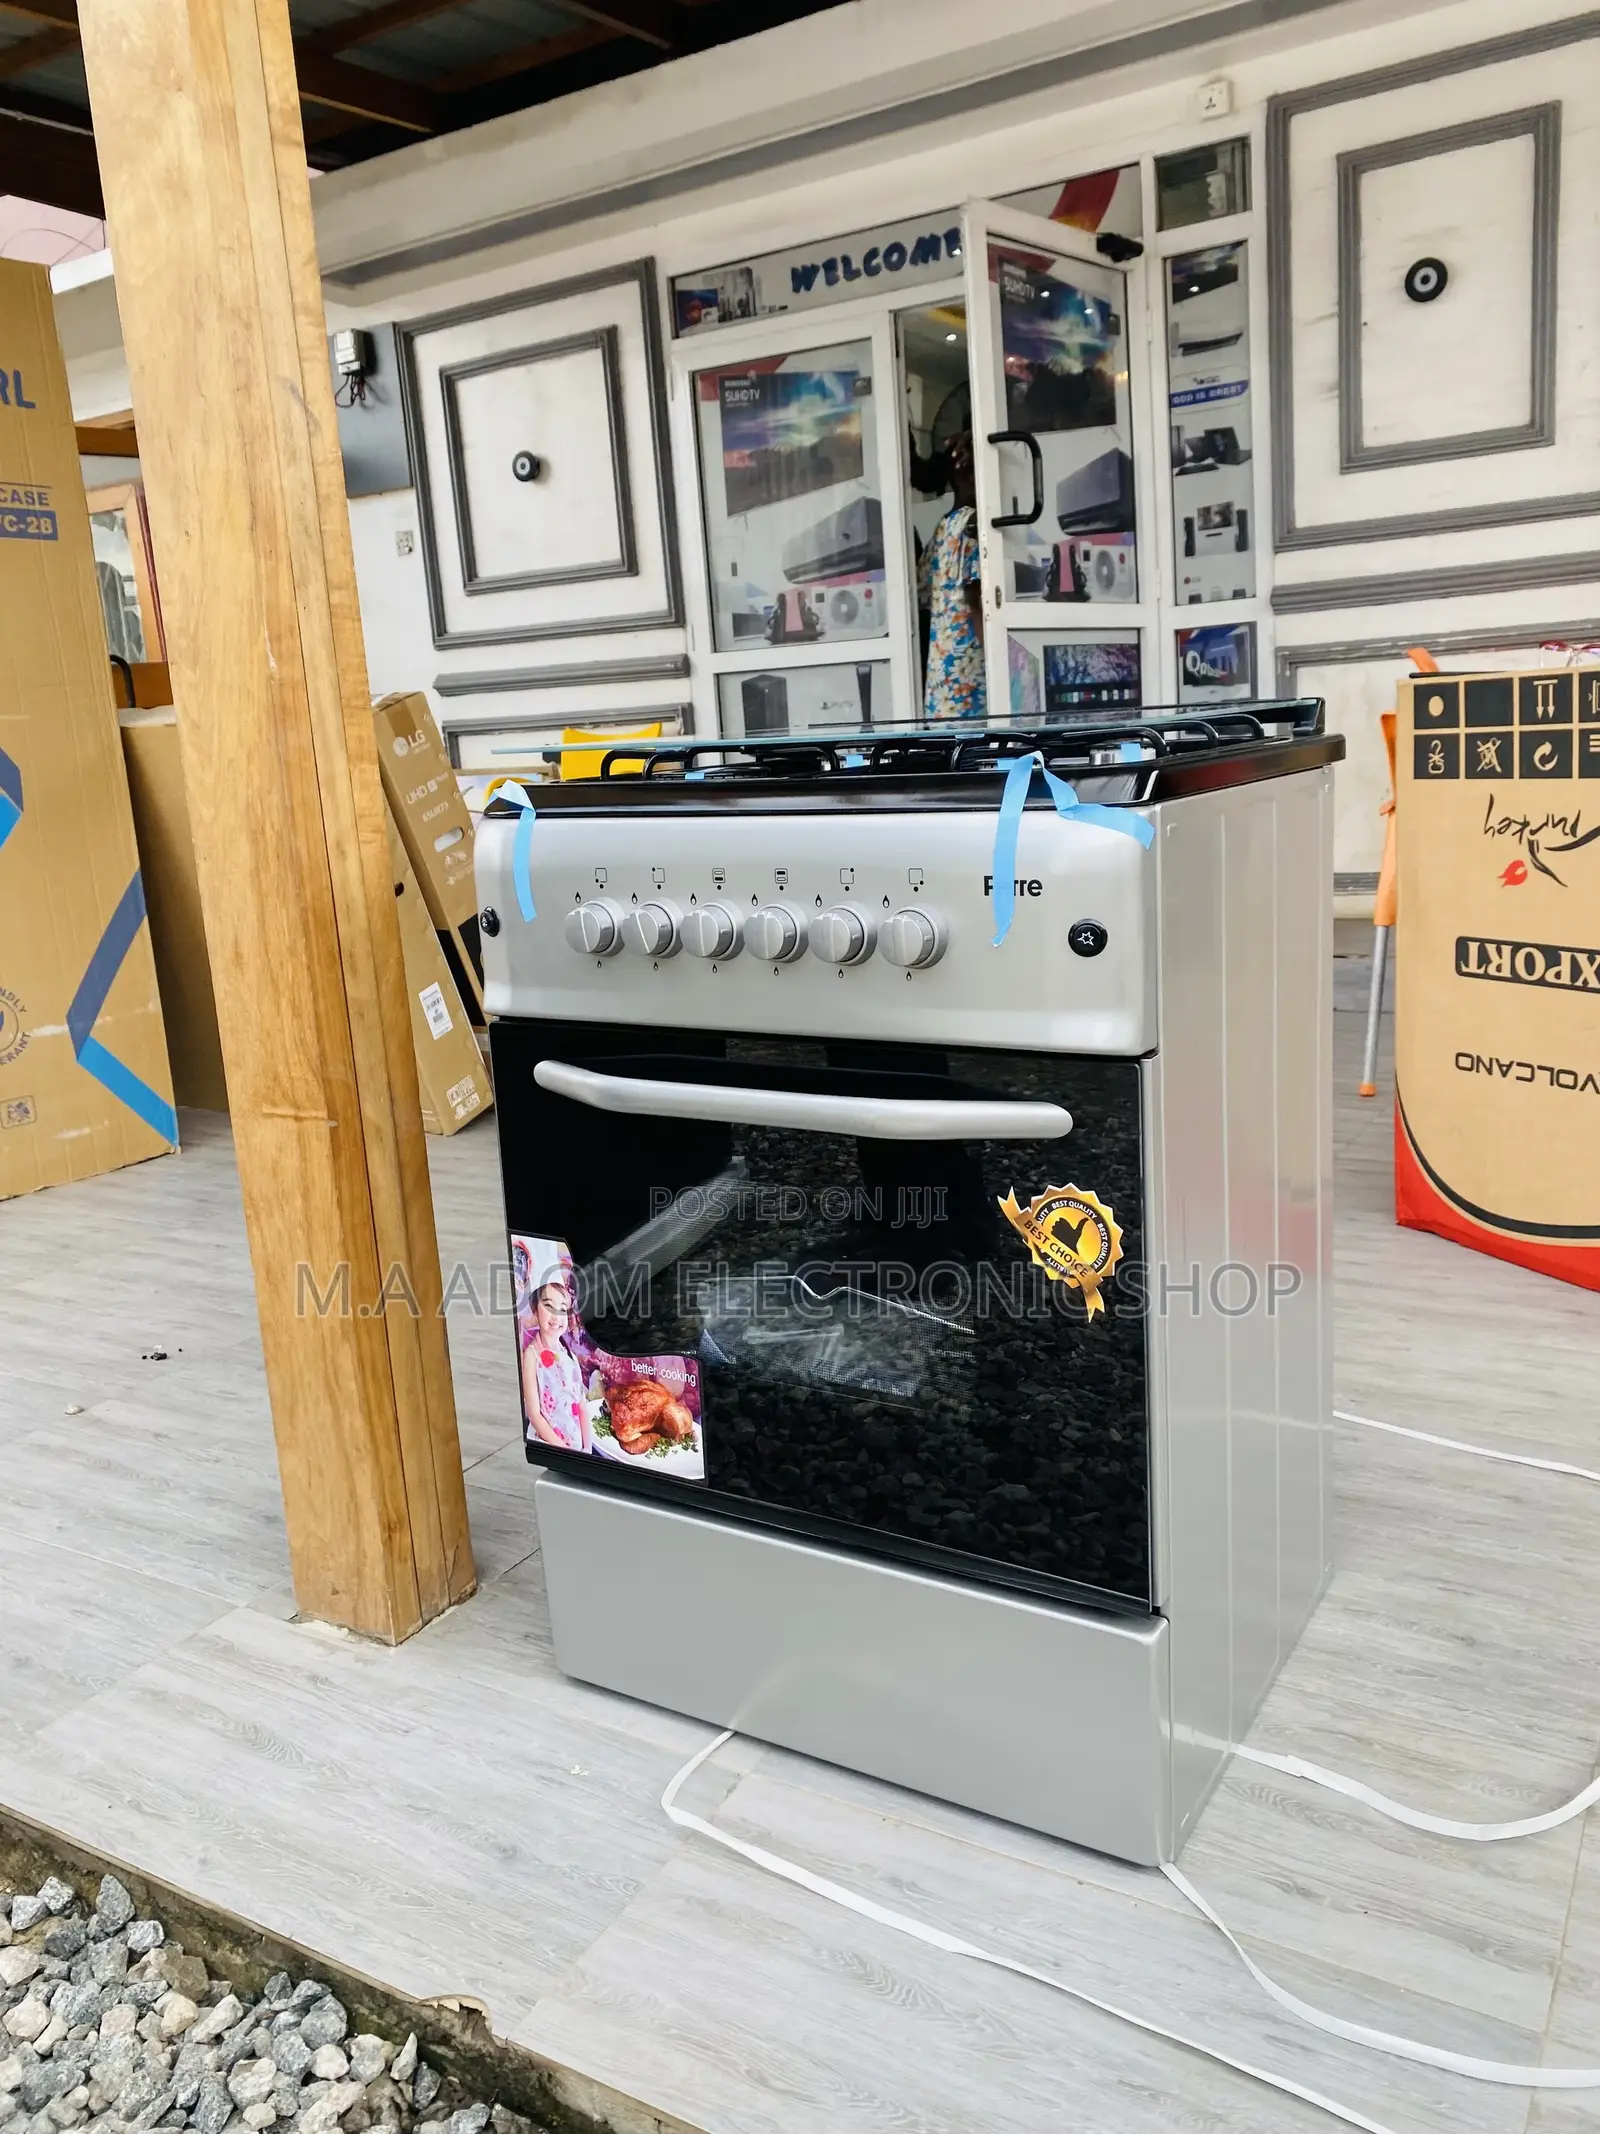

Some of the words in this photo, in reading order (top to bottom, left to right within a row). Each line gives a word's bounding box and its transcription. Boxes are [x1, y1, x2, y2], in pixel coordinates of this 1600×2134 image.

[791, 227, 962, 293] WELCOME
[408, 729, 427, 745] LG
[1051, 1199, 1068, 1210] BEST
[1068, 1200, 1098, 1219] QUALITY
[1097, 1222, 1108, 1241] BEST
[1023, 1219, 1050, 1245] BEST
[1049, 1241, 1089, 1278] CHOICE
[1093, 1241, 1109, 1270] QUALITY
[631, 1360, 657, 1376] better
[660, 1367, 696, 1387] cooking
